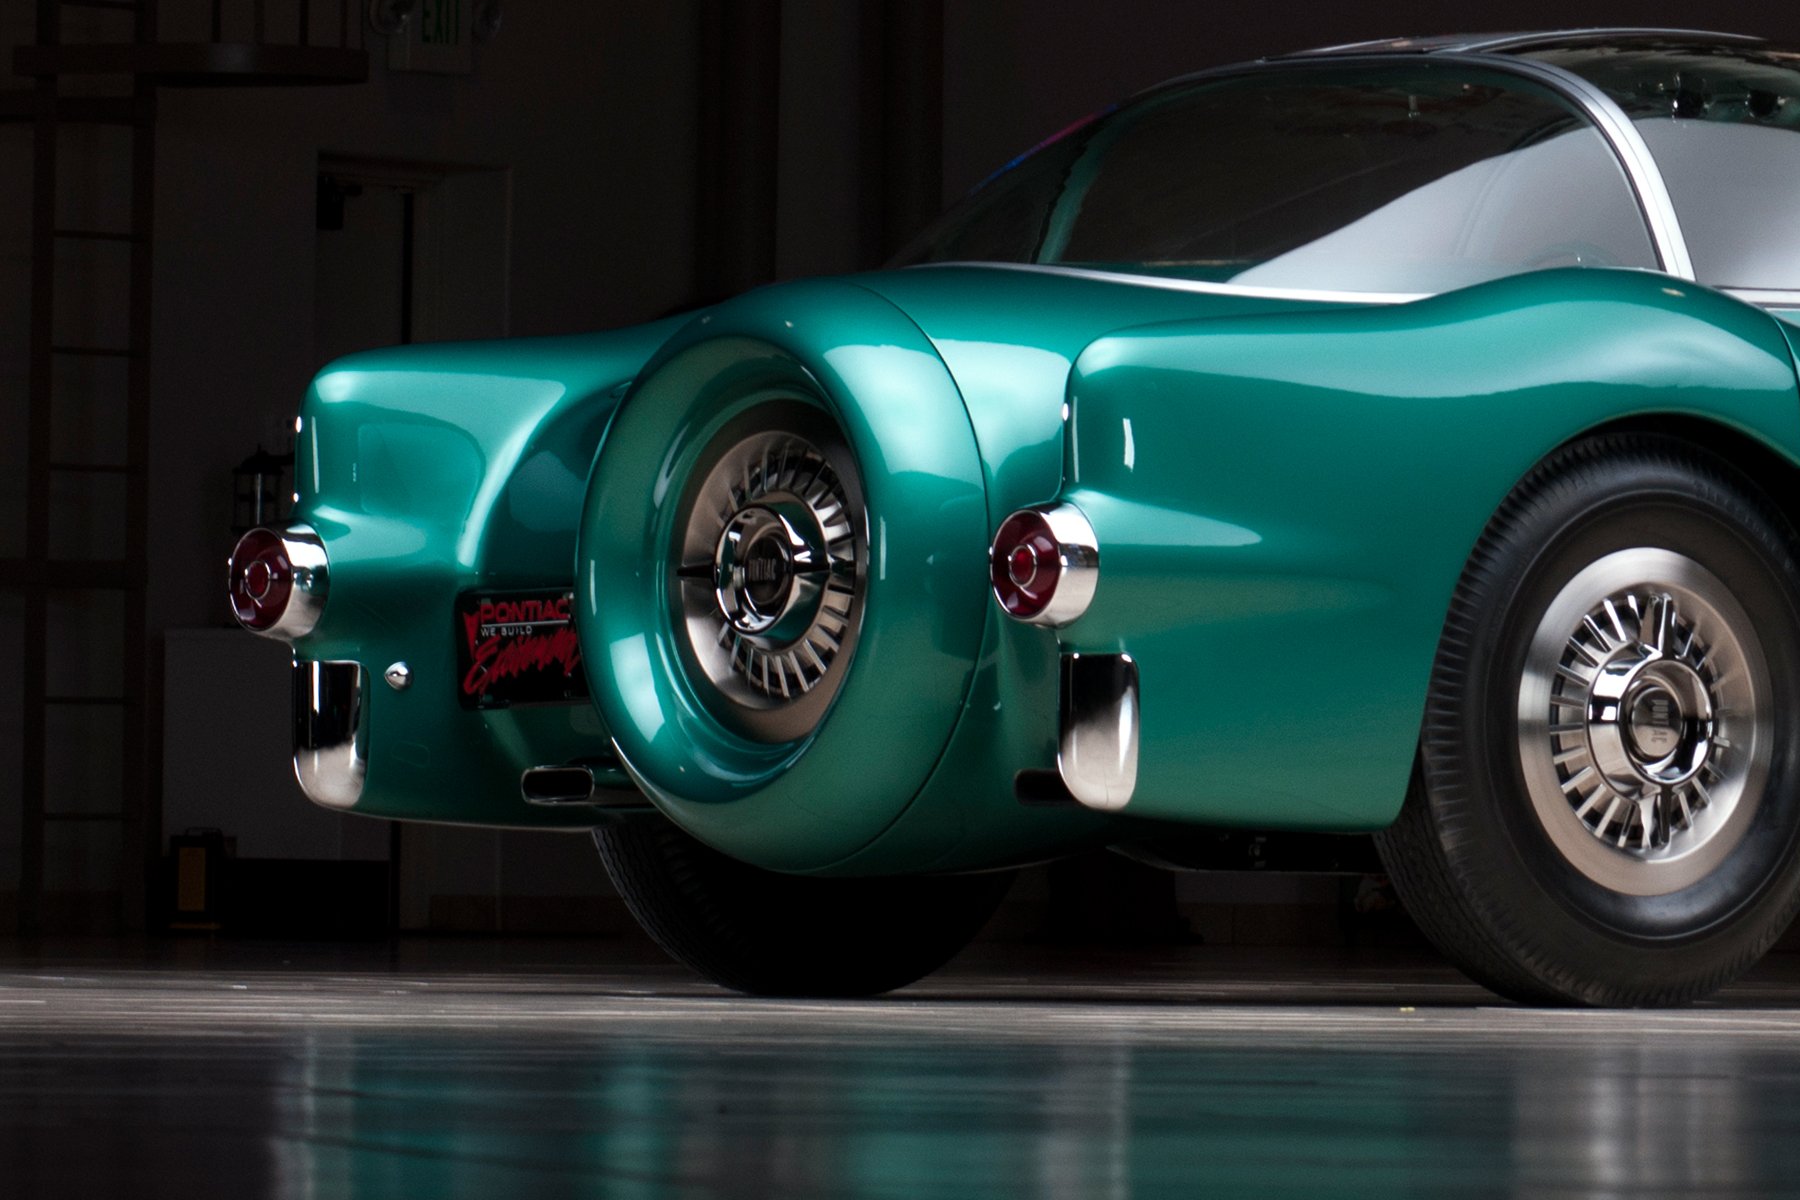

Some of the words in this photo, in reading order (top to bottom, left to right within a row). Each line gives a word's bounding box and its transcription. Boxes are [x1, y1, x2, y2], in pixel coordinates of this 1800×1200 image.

[479, 599, 570, 624] PONTIAC
[480, 626, 497, 638] WE
[501, 625, 534, 637] BUILD
